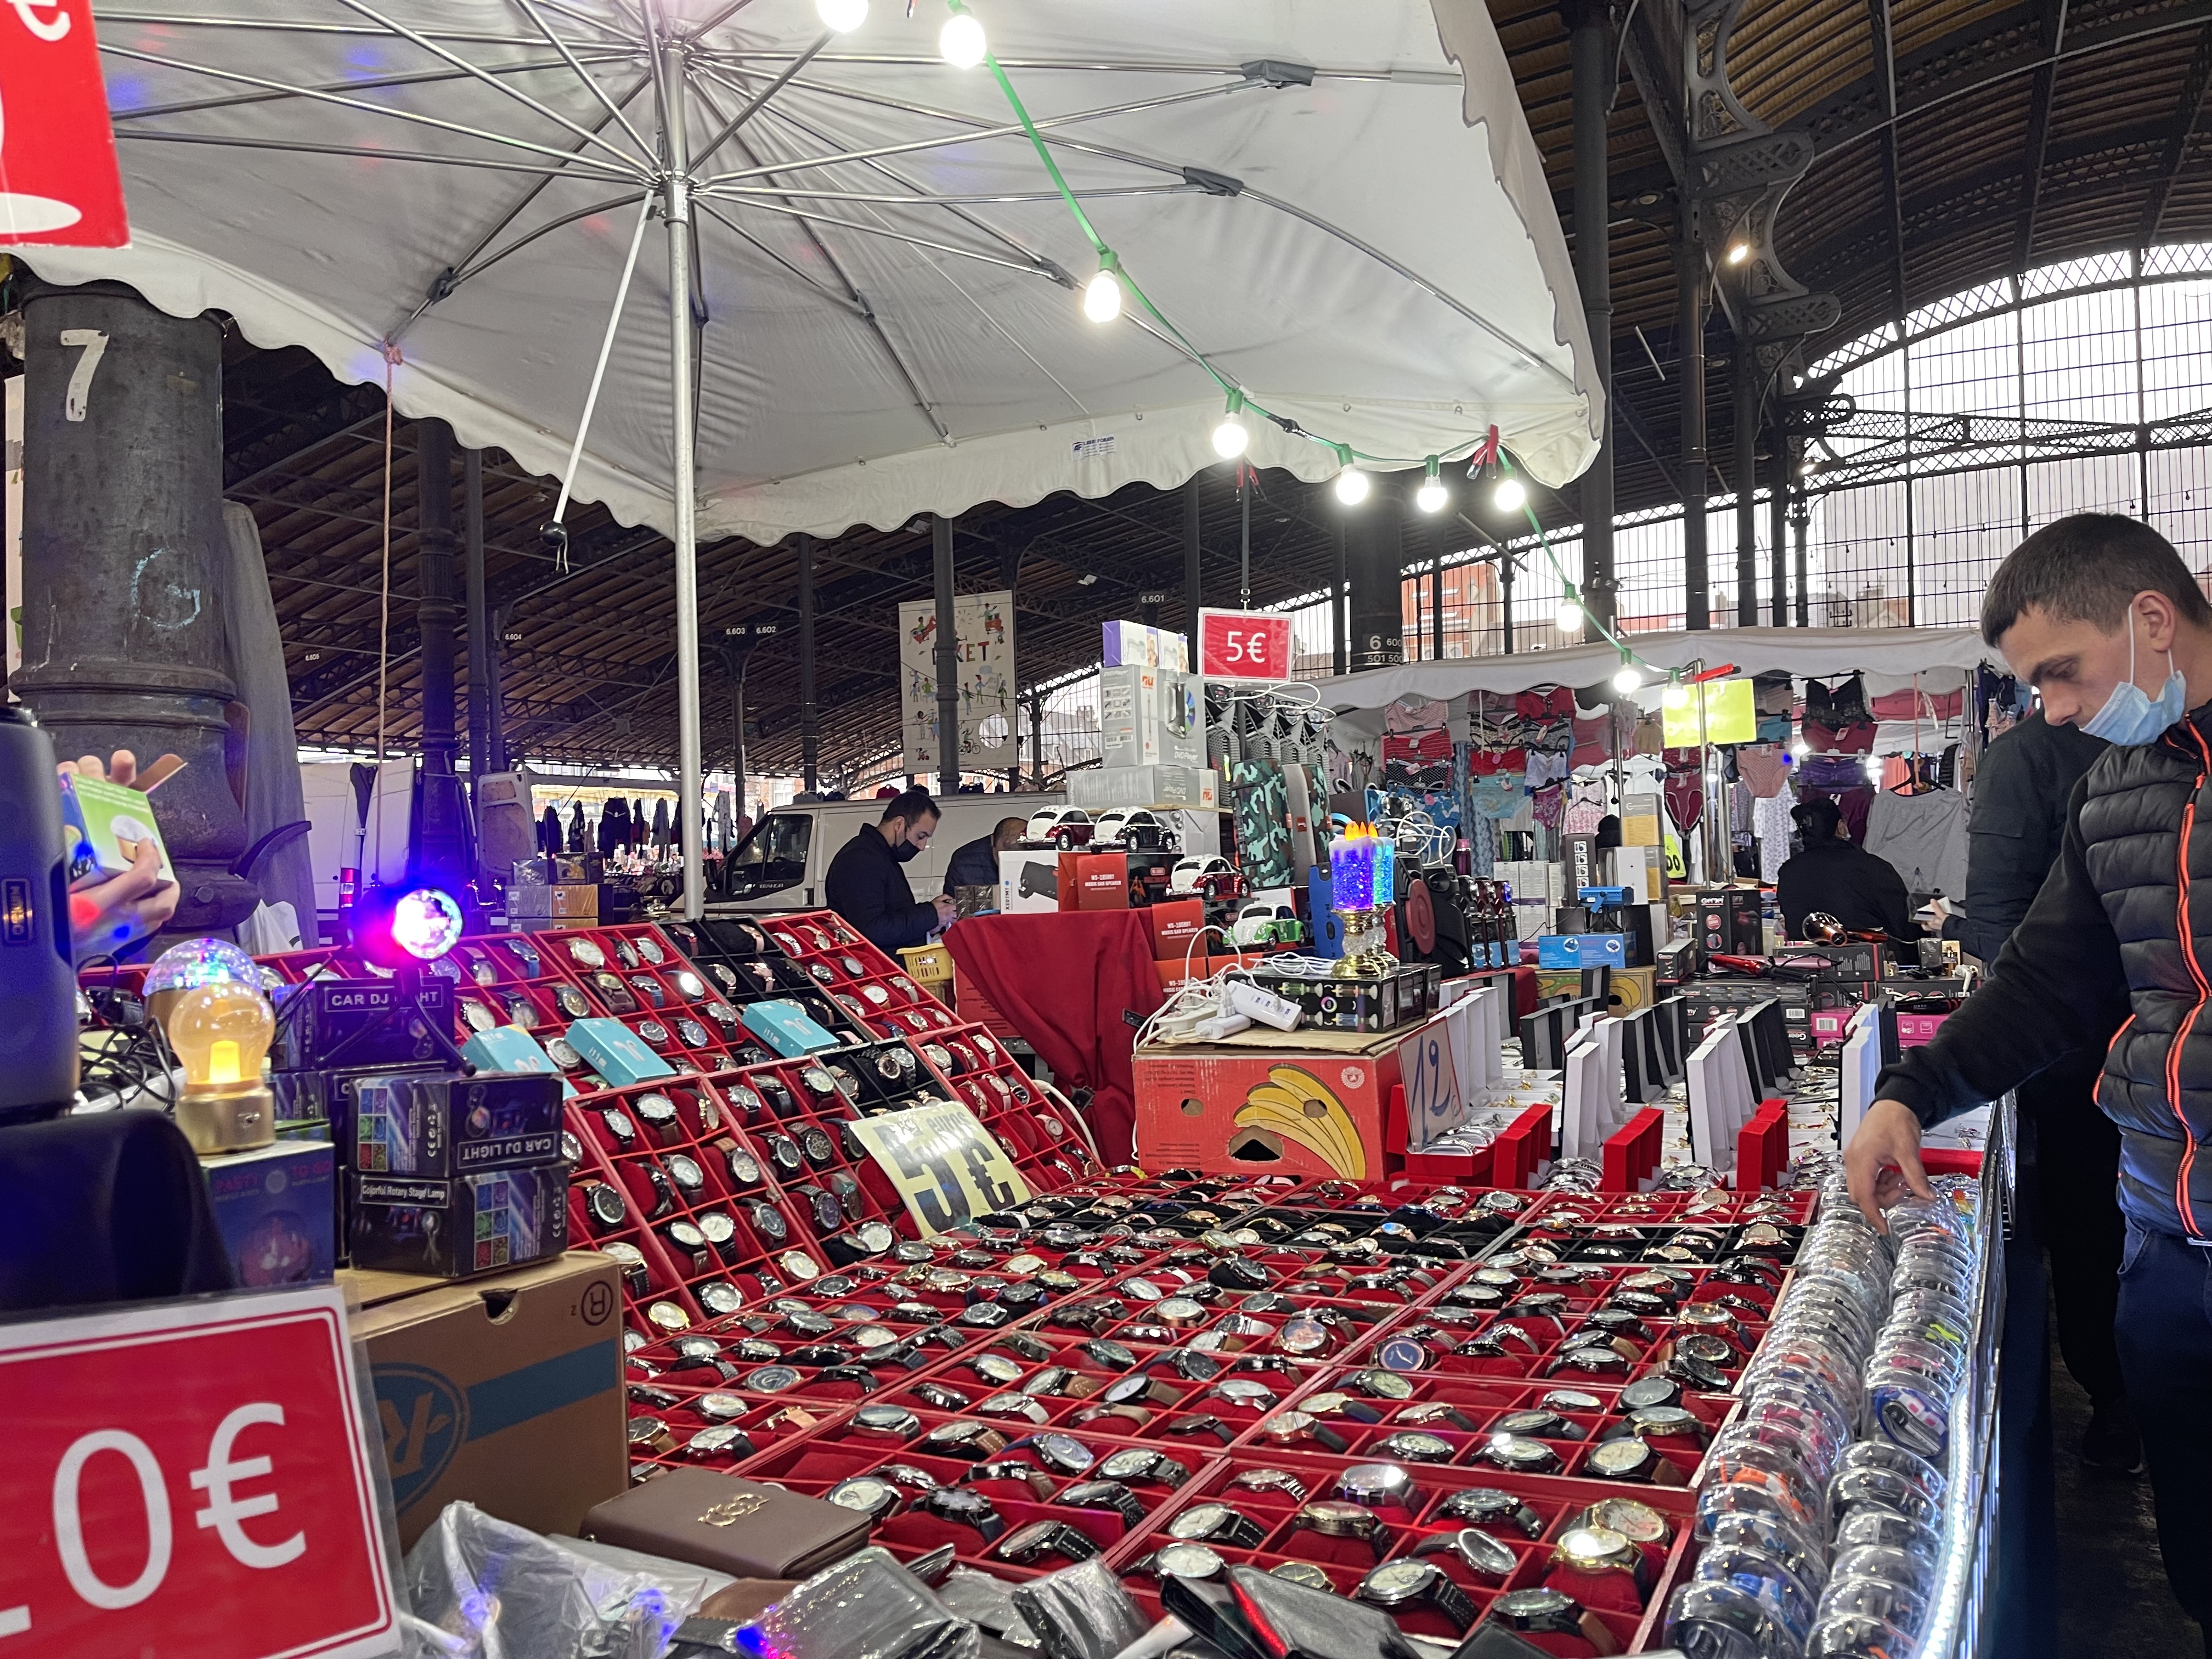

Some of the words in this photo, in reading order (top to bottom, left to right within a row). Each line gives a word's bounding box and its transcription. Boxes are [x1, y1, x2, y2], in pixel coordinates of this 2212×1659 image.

[60, 329, 110, 422] 7
[1141, 595, 1165, 603] 6.601
[756, 626, 776, 634] 6.602
[1226, 630, 1267, 663] 5€
[1369, 635, 1382, 651] 6
[1386, 637, 1403, 647] 600
[1367, 654, 1386, 663] 501
[1387, 654, 1404, 663] 500
[331, 994, 365, 1006] CAR
[370, 993, 389, 1005] DJ
[505, 1142, 522, 1154] DJ
[526, 1138, 551, 1150] CAR
[462, 1144, 502, 1160] LIGHT
[362, 1184, 386, 1197] Colorful
[387, 1186, 408, 1198] Rotary
[408, 1187, 426, 1200] Stage
[427, 1189, 445, 1200] Lamp
[0, 1402, 307, 1637] 0€
